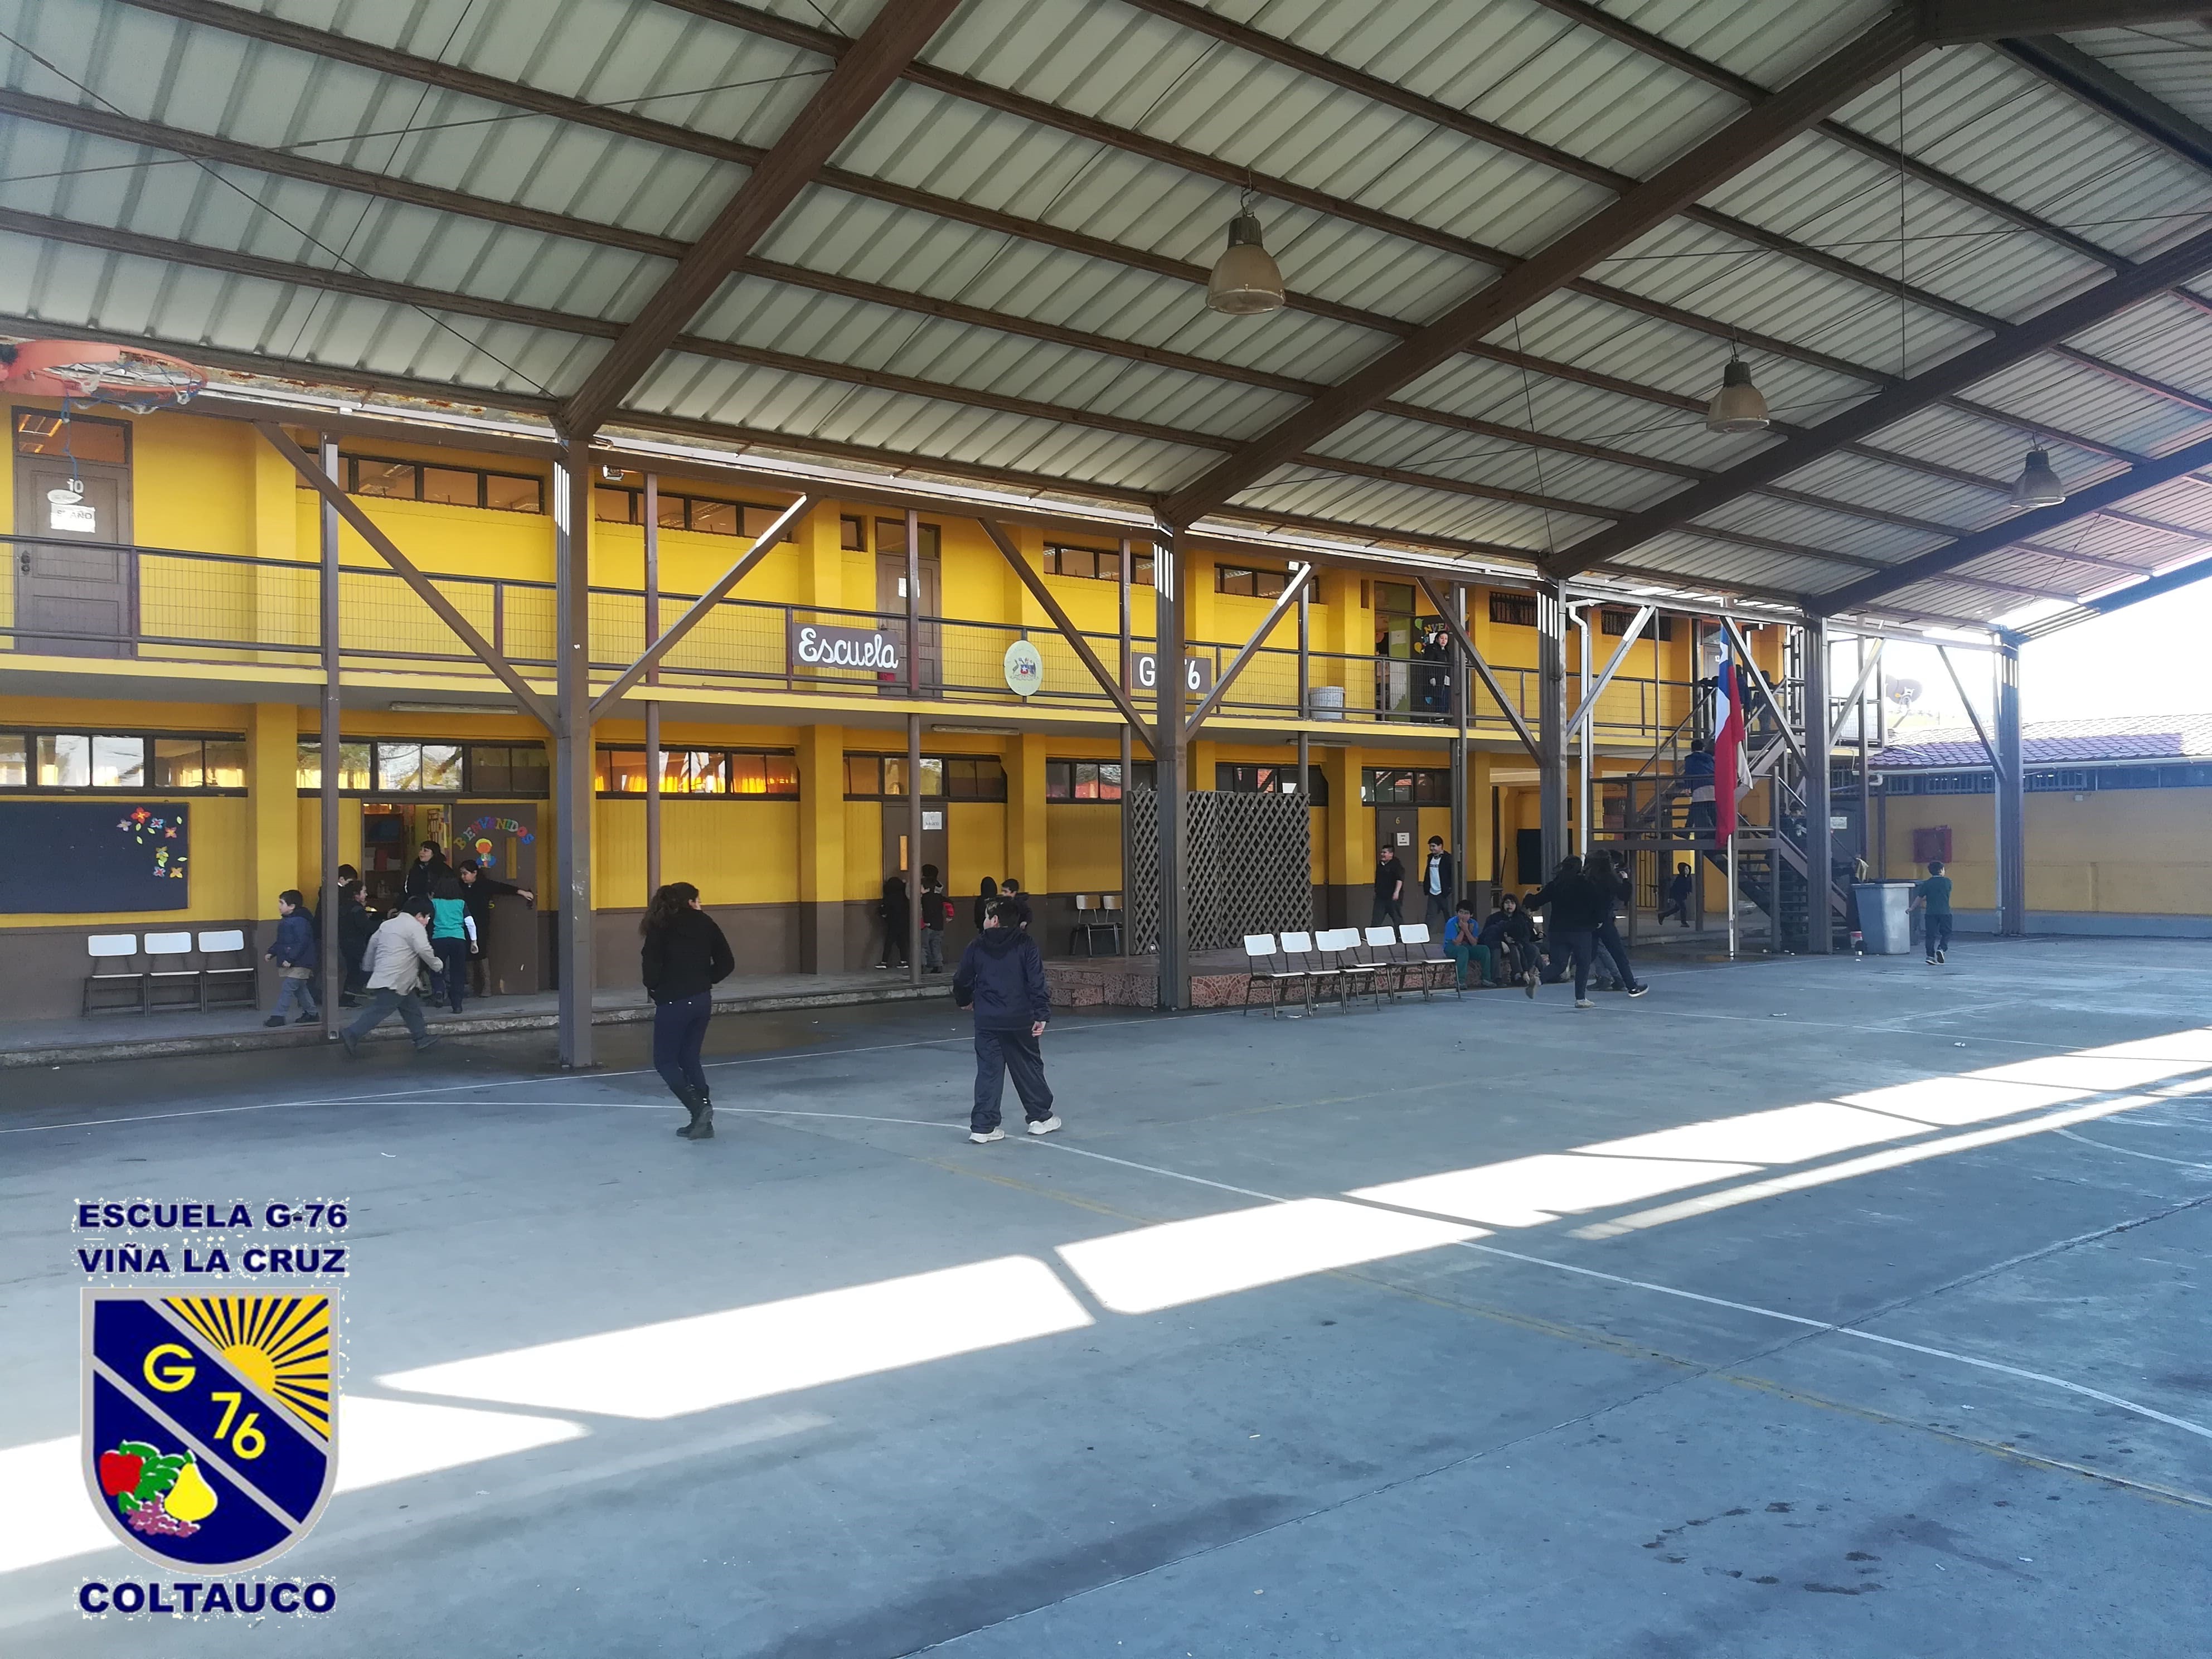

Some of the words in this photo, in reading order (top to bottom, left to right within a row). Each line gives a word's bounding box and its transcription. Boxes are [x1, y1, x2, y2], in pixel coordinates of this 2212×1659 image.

[67, 478, 84, 493] 10
[798, 627, 899, 669] Escuela
[454, 816, 535, 850] BIENVENIDOS
